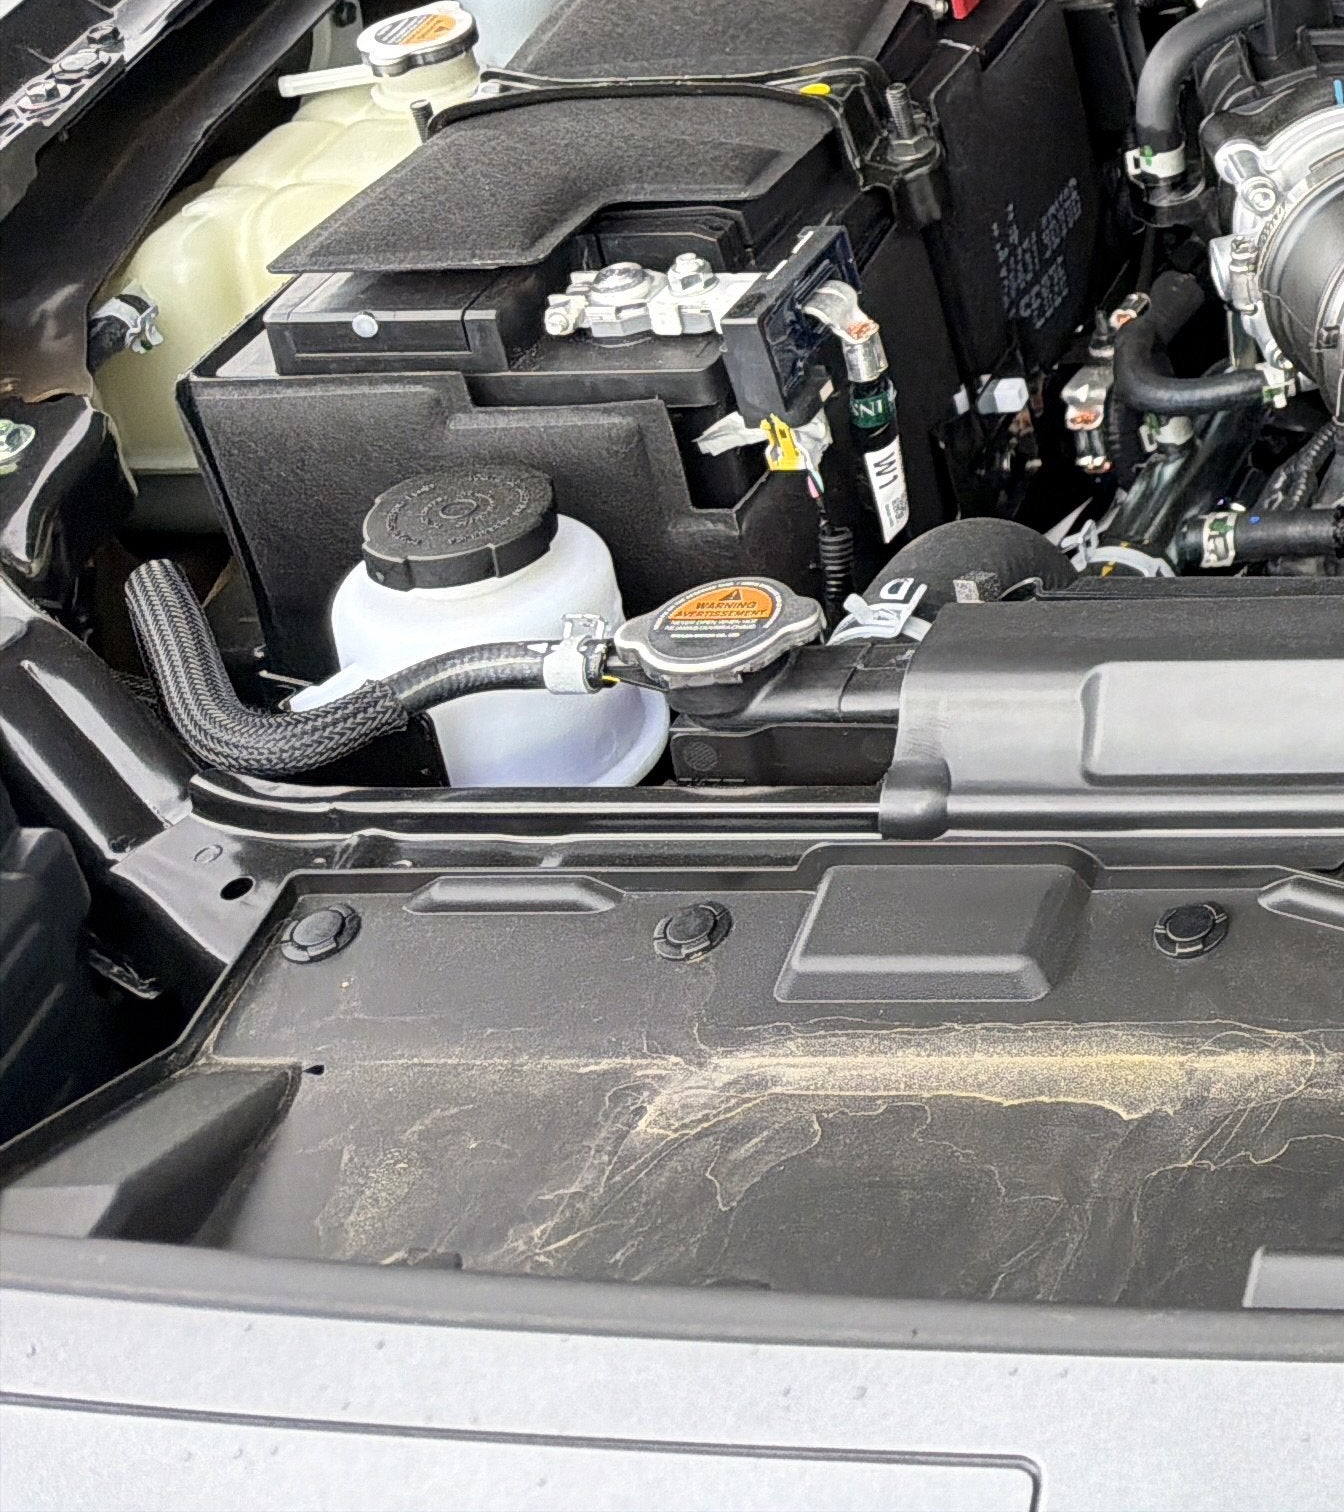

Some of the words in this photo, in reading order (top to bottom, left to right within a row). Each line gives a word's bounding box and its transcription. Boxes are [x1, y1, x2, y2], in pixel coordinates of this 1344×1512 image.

[873, 451, 899, 490] W1
[695, 601, 758, 609] WARNING
[674, 609, 768, 617] AVERTISSEMENT
